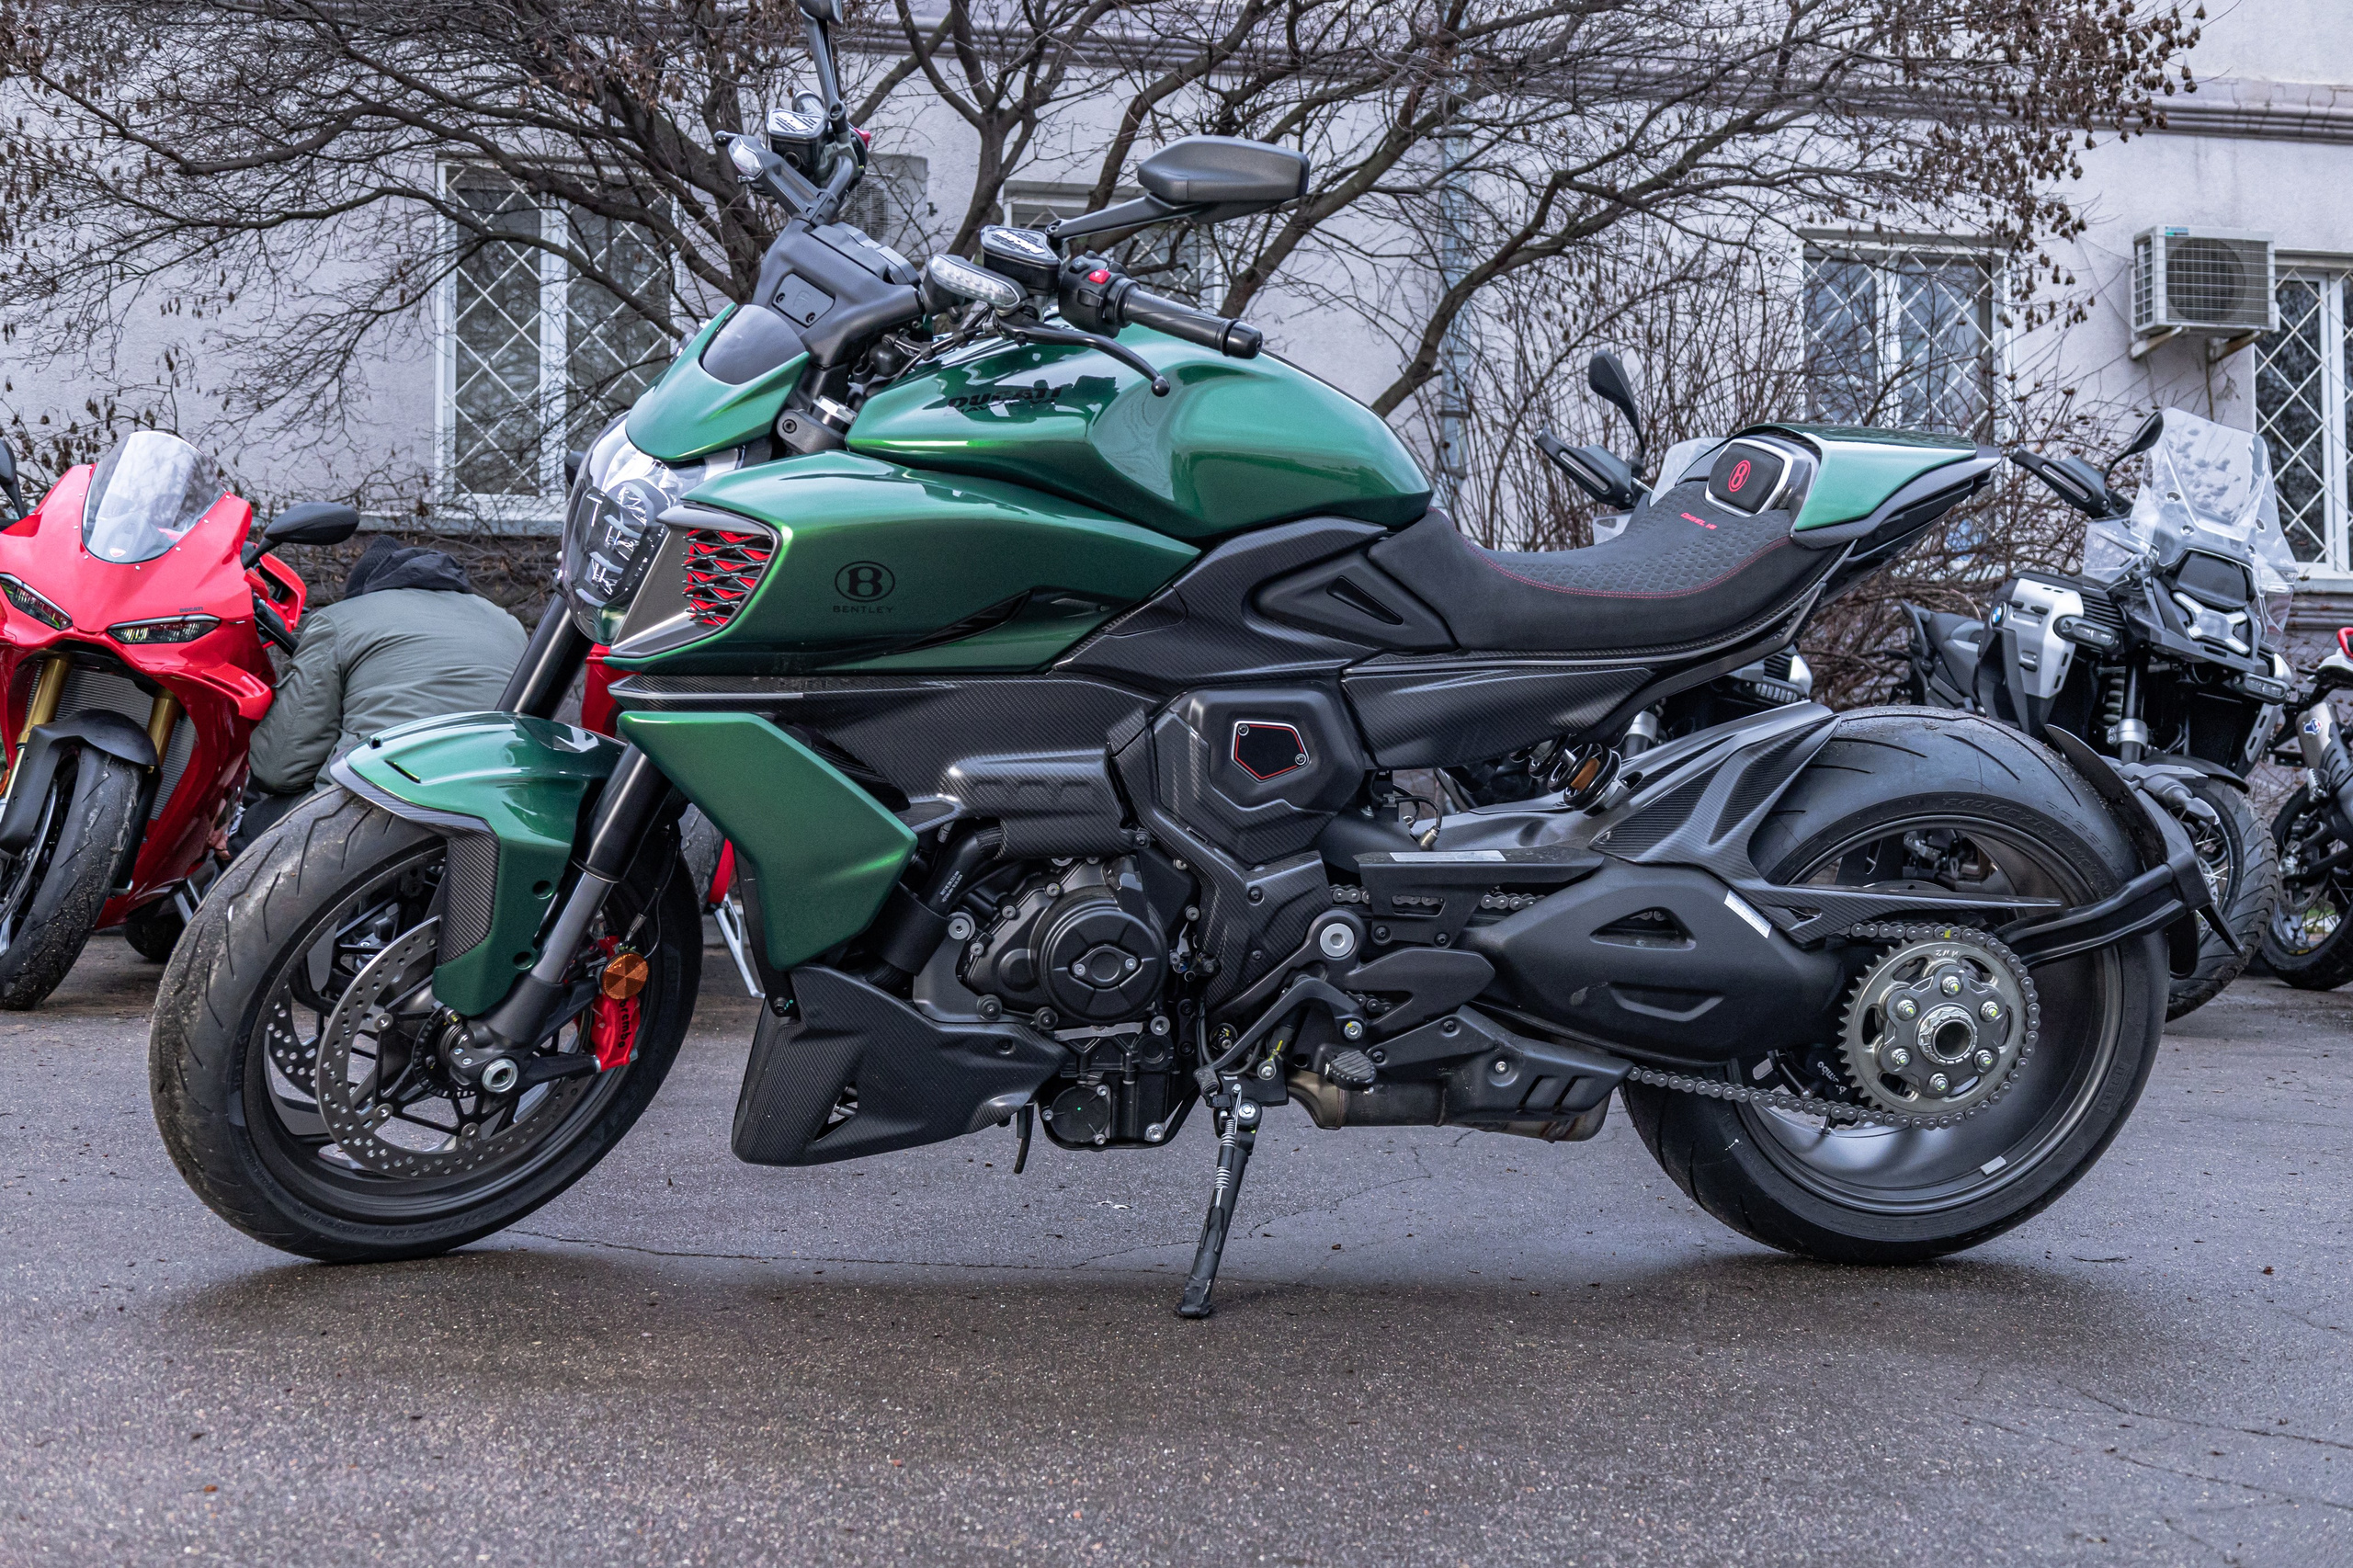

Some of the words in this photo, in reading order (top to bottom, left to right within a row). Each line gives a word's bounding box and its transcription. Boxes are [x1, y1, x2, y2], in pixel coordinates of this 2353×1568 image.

[948, 387, 1063, 407] DUCATI
[833, 605, 894, 614] BENTLEY
[618, 998, 631, 1048] brembo
